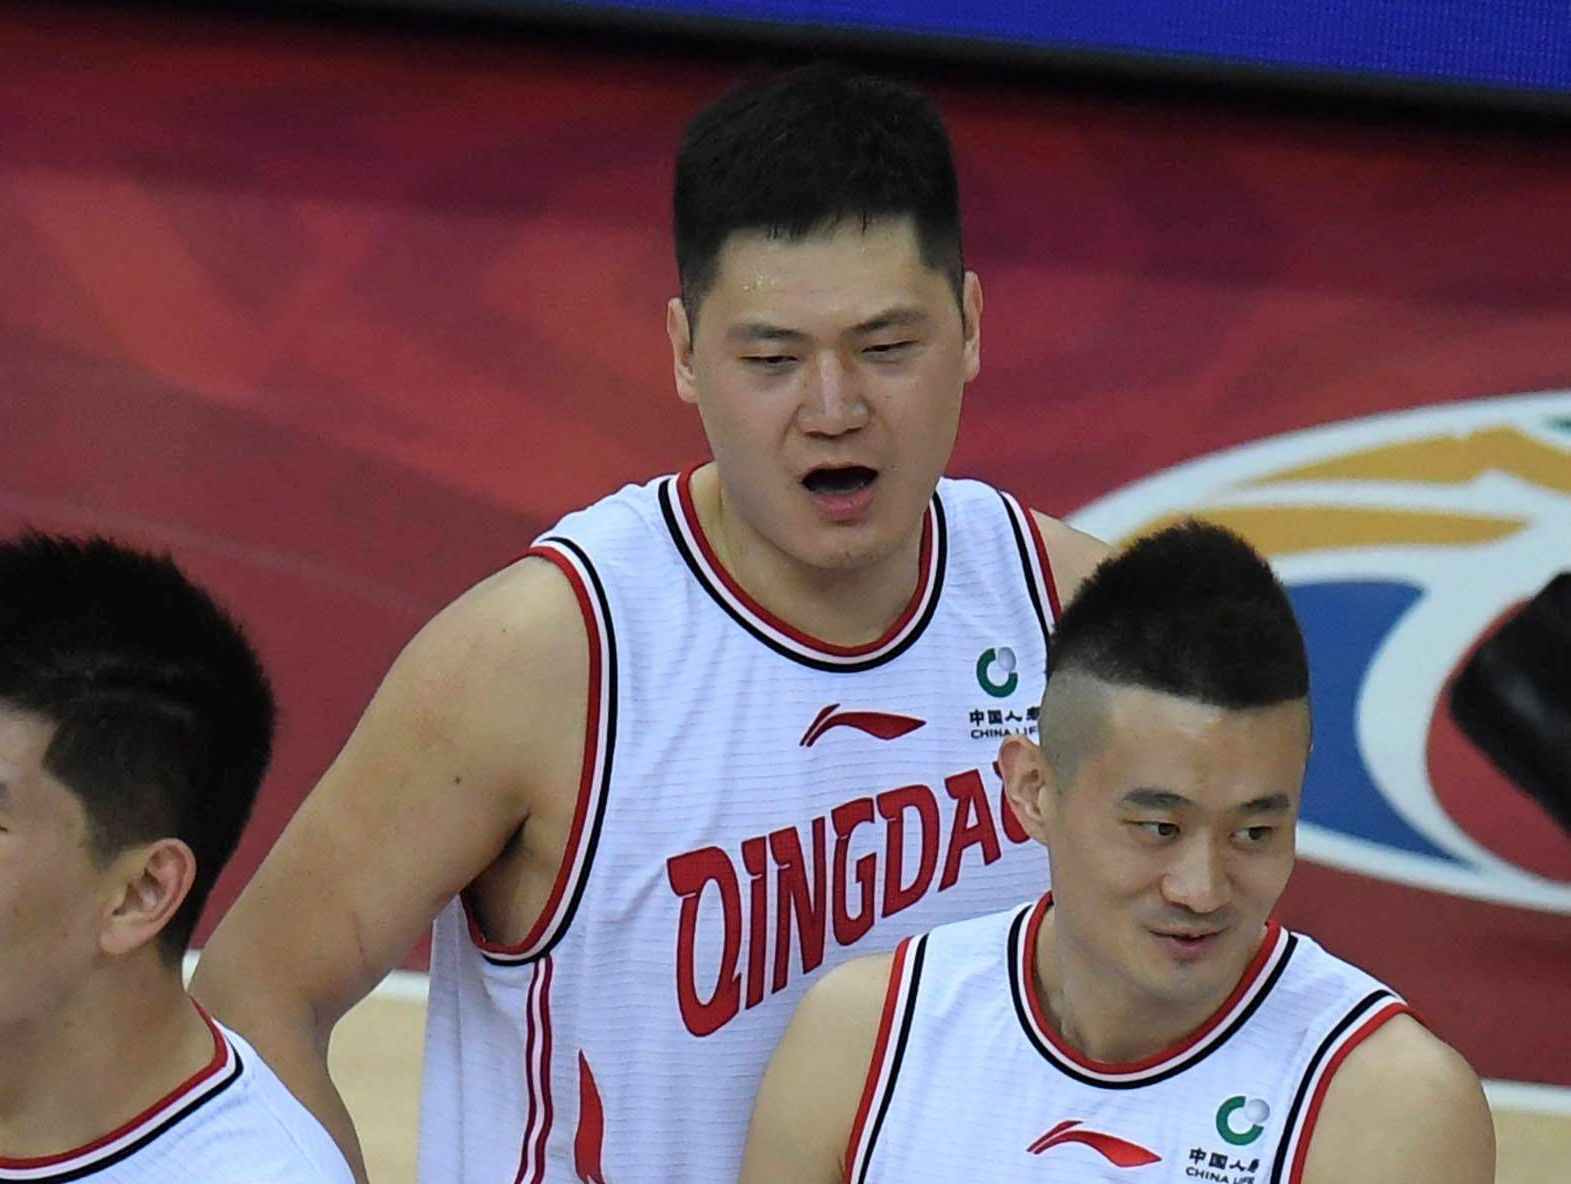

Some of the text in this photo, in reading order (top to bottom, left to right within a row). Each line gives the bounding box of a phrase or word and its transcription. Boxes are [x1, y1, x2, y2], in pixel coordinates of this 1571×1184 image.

[970, 728, 1011, 739] CHINA
[1188, 1147, 1260, 1173] 中国人寿
[1185, 1166, 1229, 1184] CHINA
